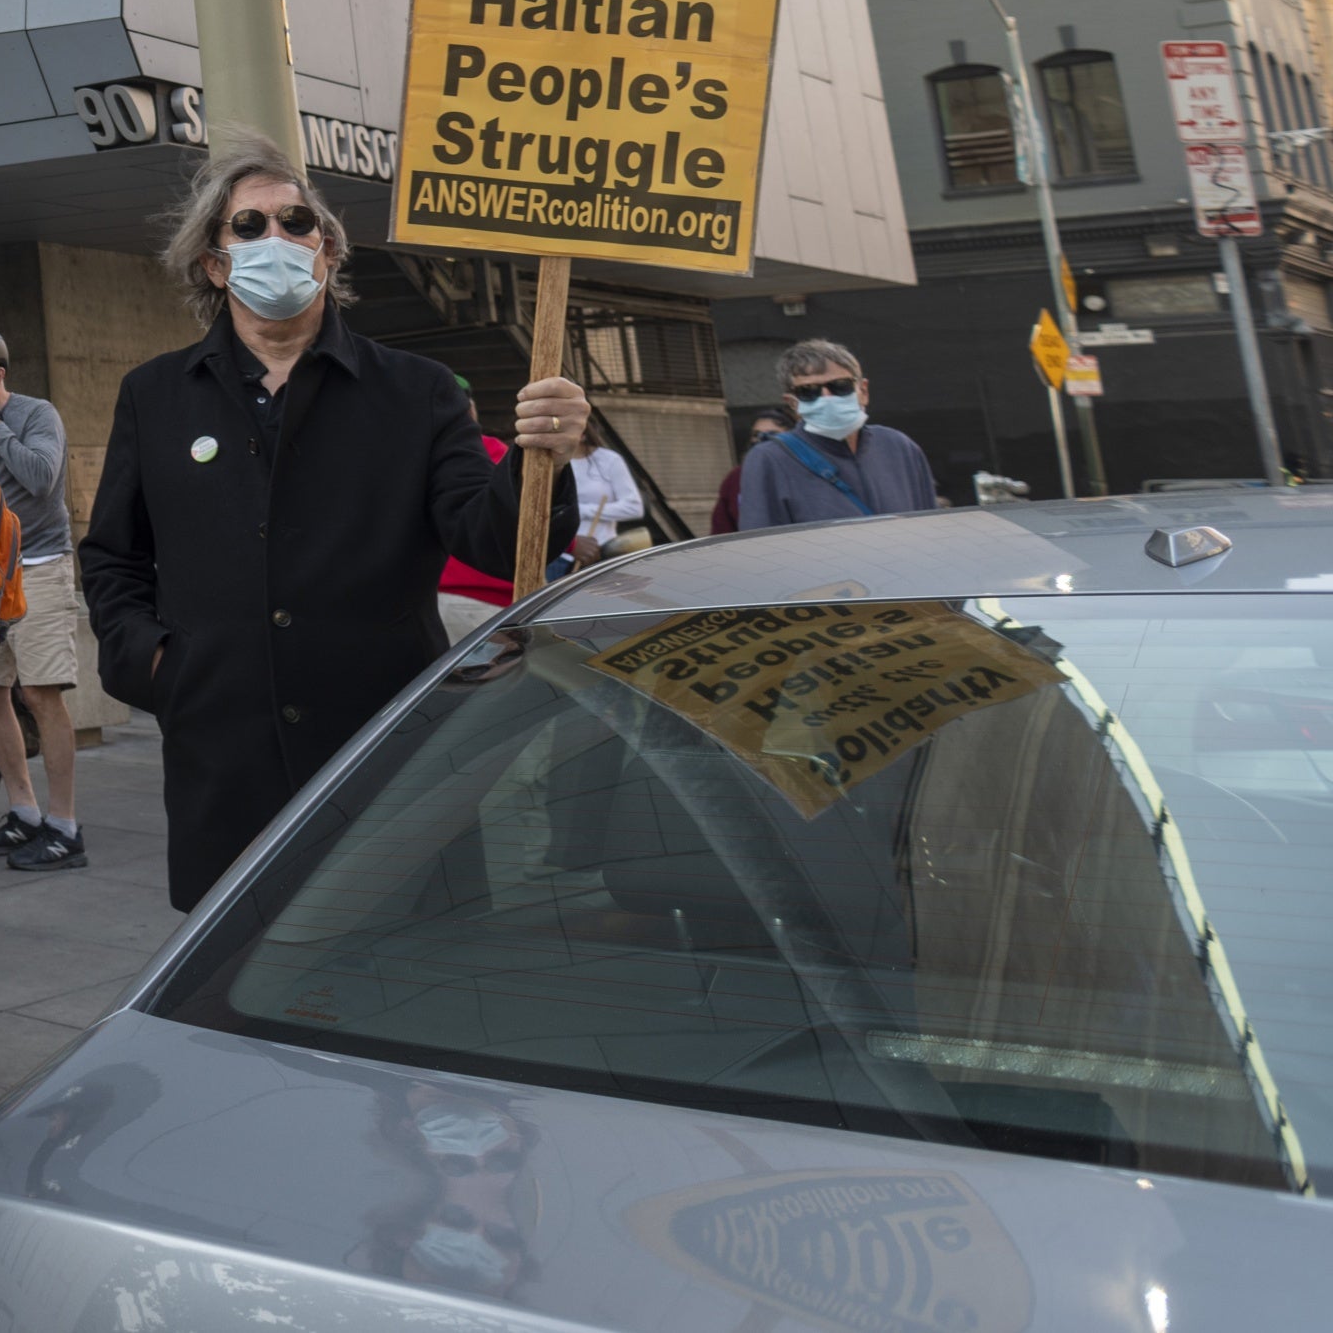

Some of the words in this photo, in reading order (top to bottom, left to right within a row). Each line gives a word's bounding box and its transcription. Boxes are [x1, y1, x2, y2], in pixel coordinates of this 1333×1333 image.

[75, 84, 157, 148] 90
[442, 43, 729, 121] People's
[432, 111, 726, 193] Struggle
[413, 177, 733, 251] ANSWERcoalition.org
